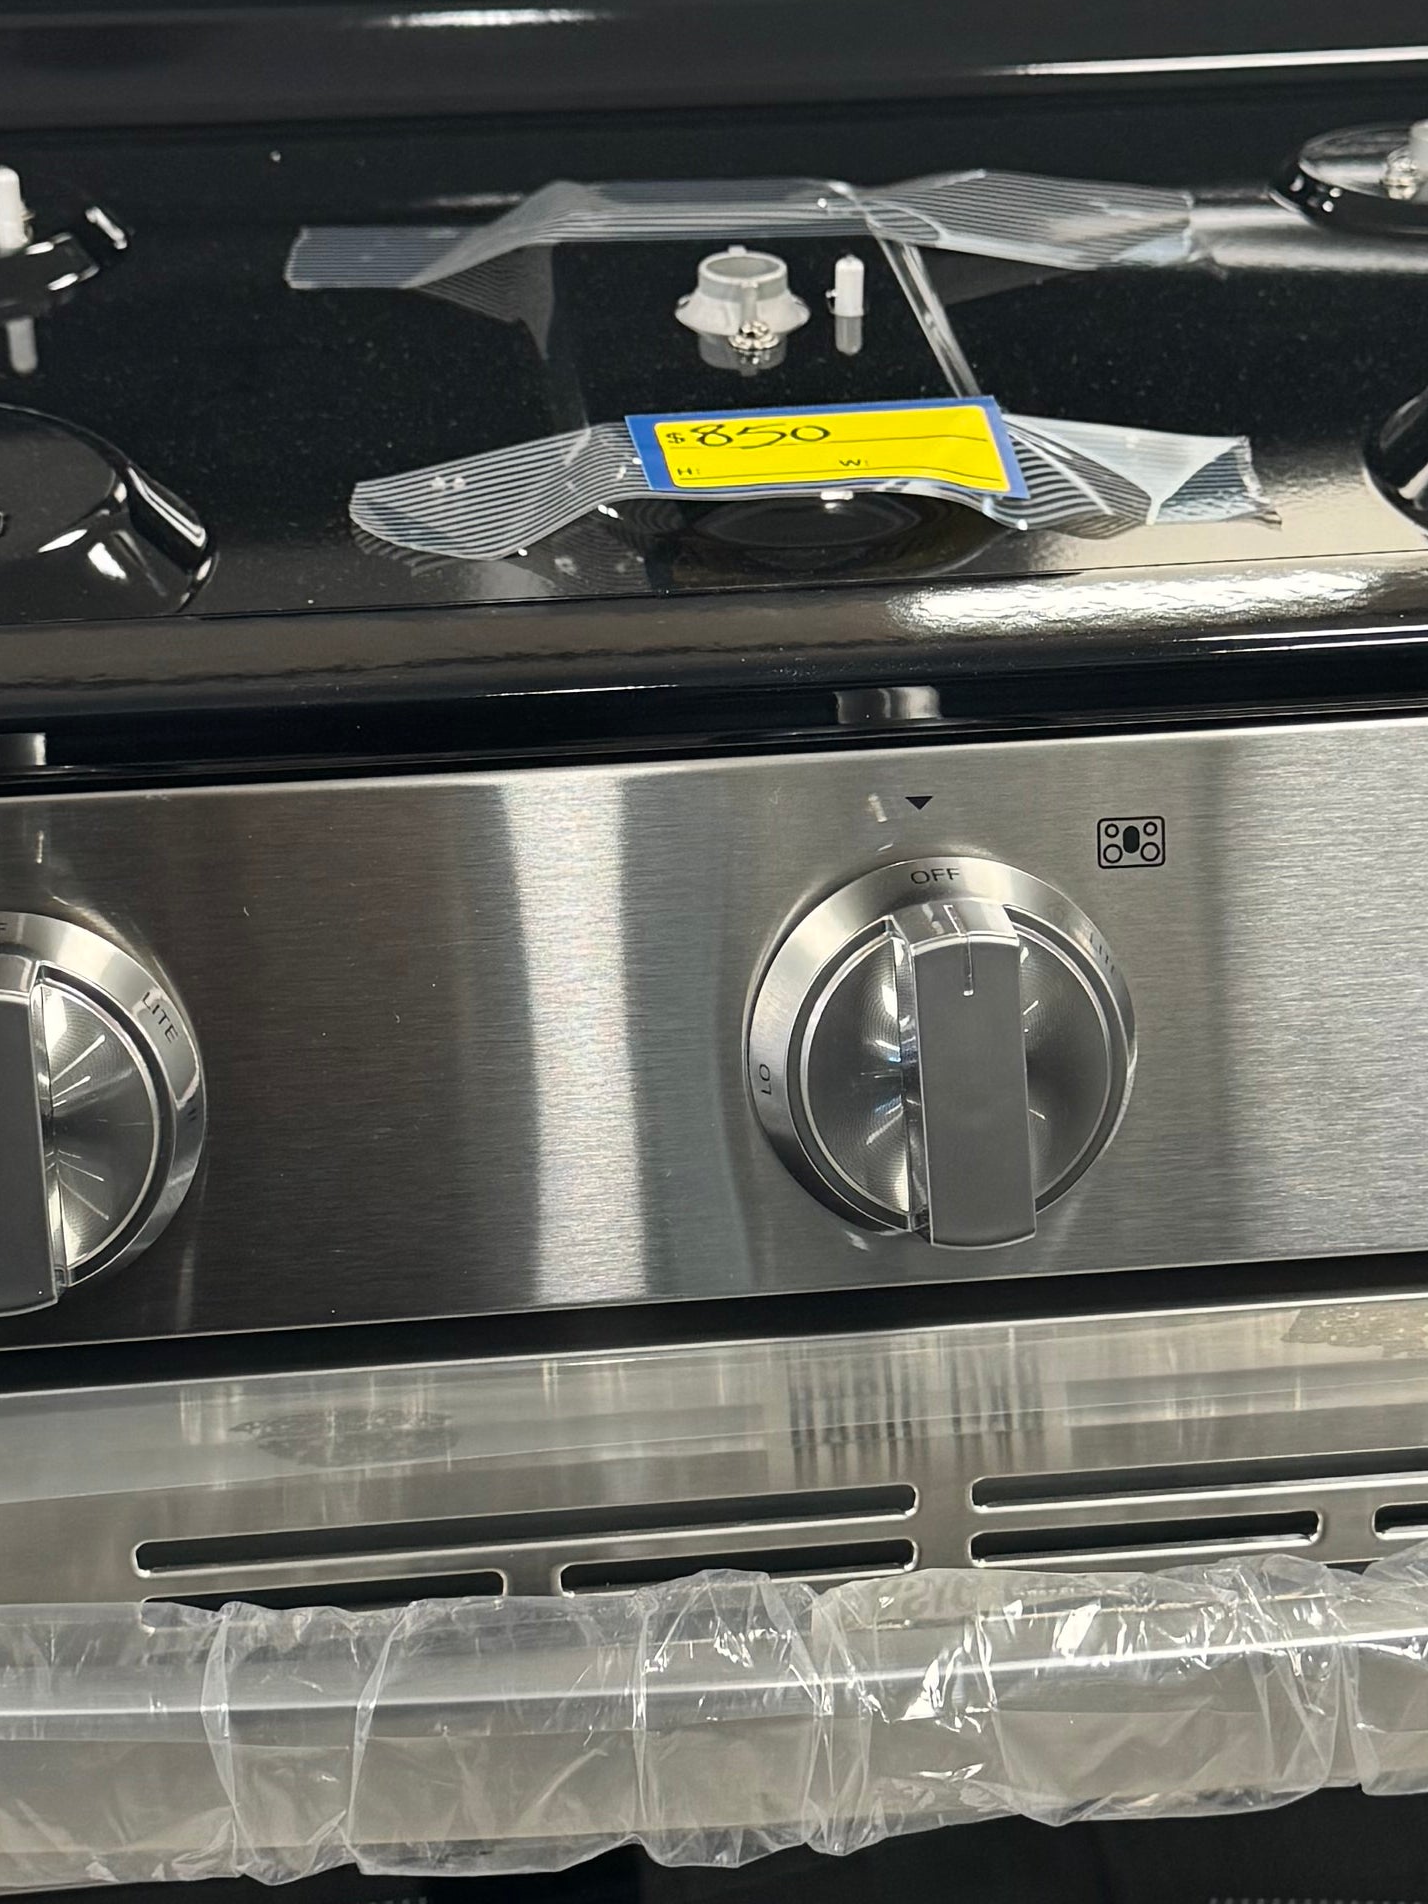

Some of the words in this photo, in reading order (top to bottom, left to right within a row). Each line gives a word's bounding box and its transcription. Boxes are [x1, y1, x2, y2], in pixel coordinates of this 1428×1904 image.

[910, 866, 962, 886] OFF
[141, 990, 180, 1043] LITE
[758, 1062, 772, 1096] LO
